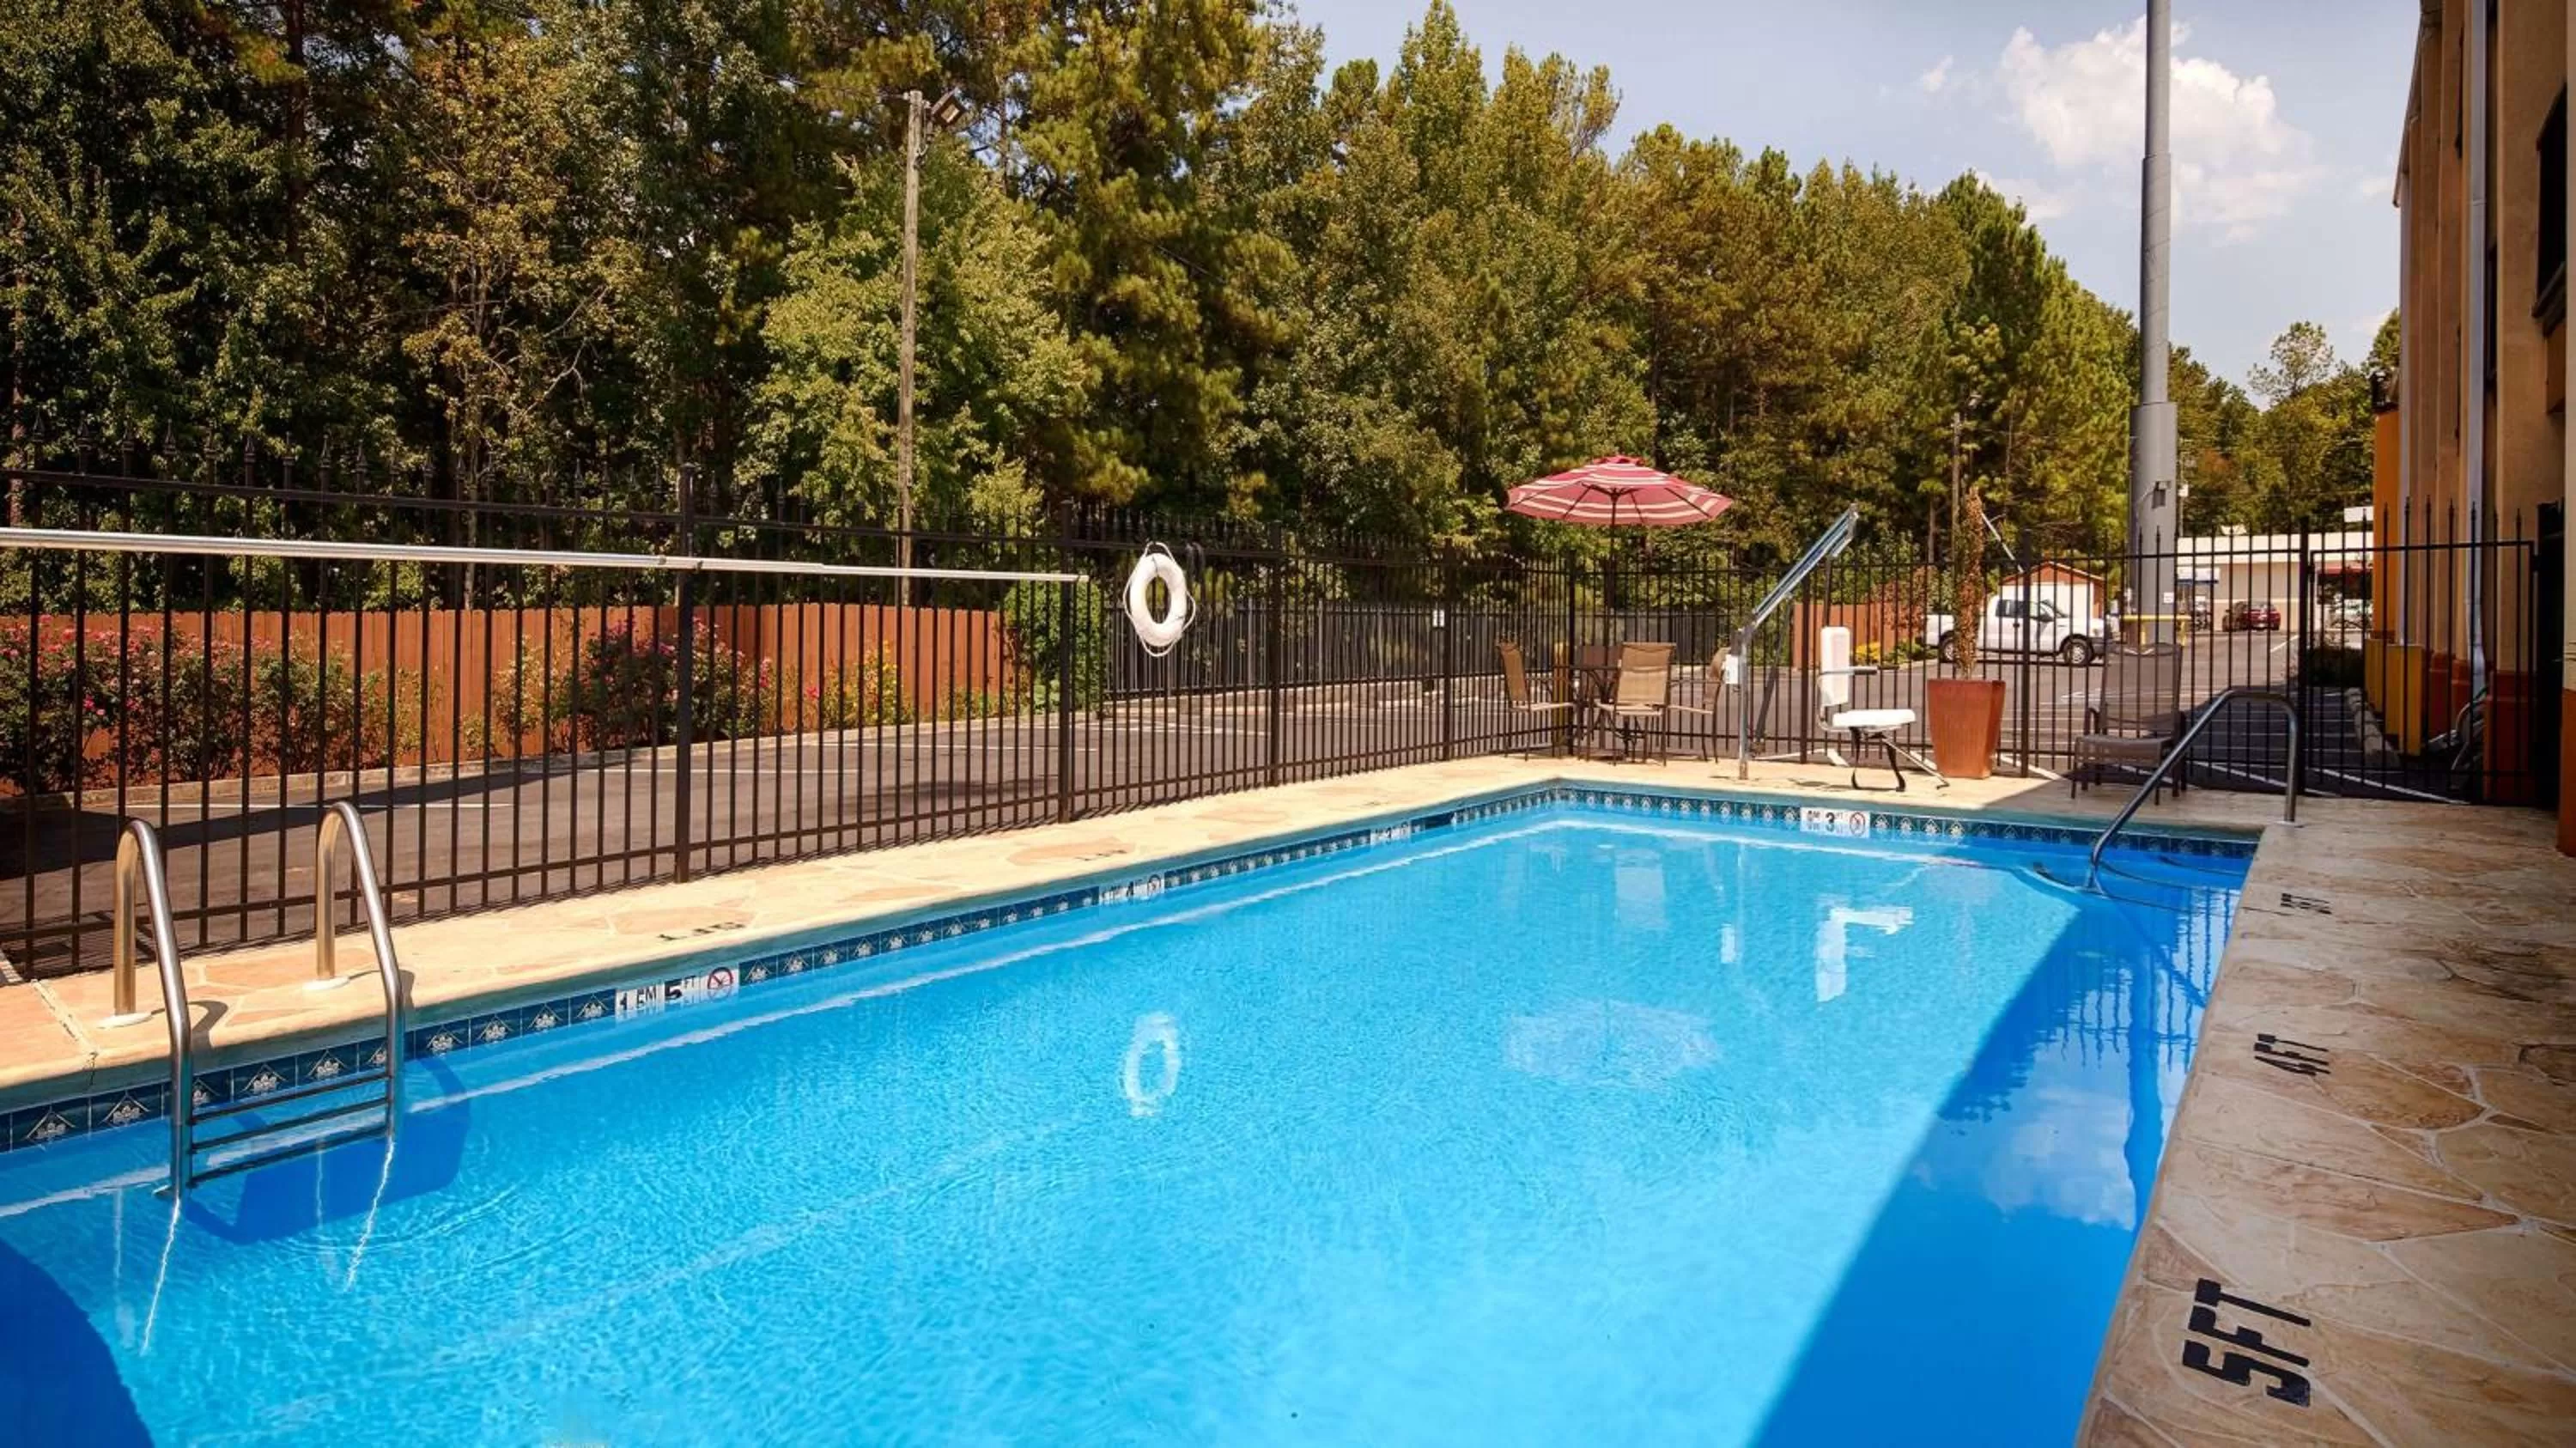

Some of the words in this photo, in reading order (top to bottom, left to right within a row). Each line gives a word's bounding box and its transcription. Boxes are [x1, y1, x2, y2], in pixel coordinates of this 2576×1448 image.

[665, 979, 683, 1001] 5
[2253, 1033, 2331, 1076] 4FT
[2183, 1278, 2312, 1407] 5FT
